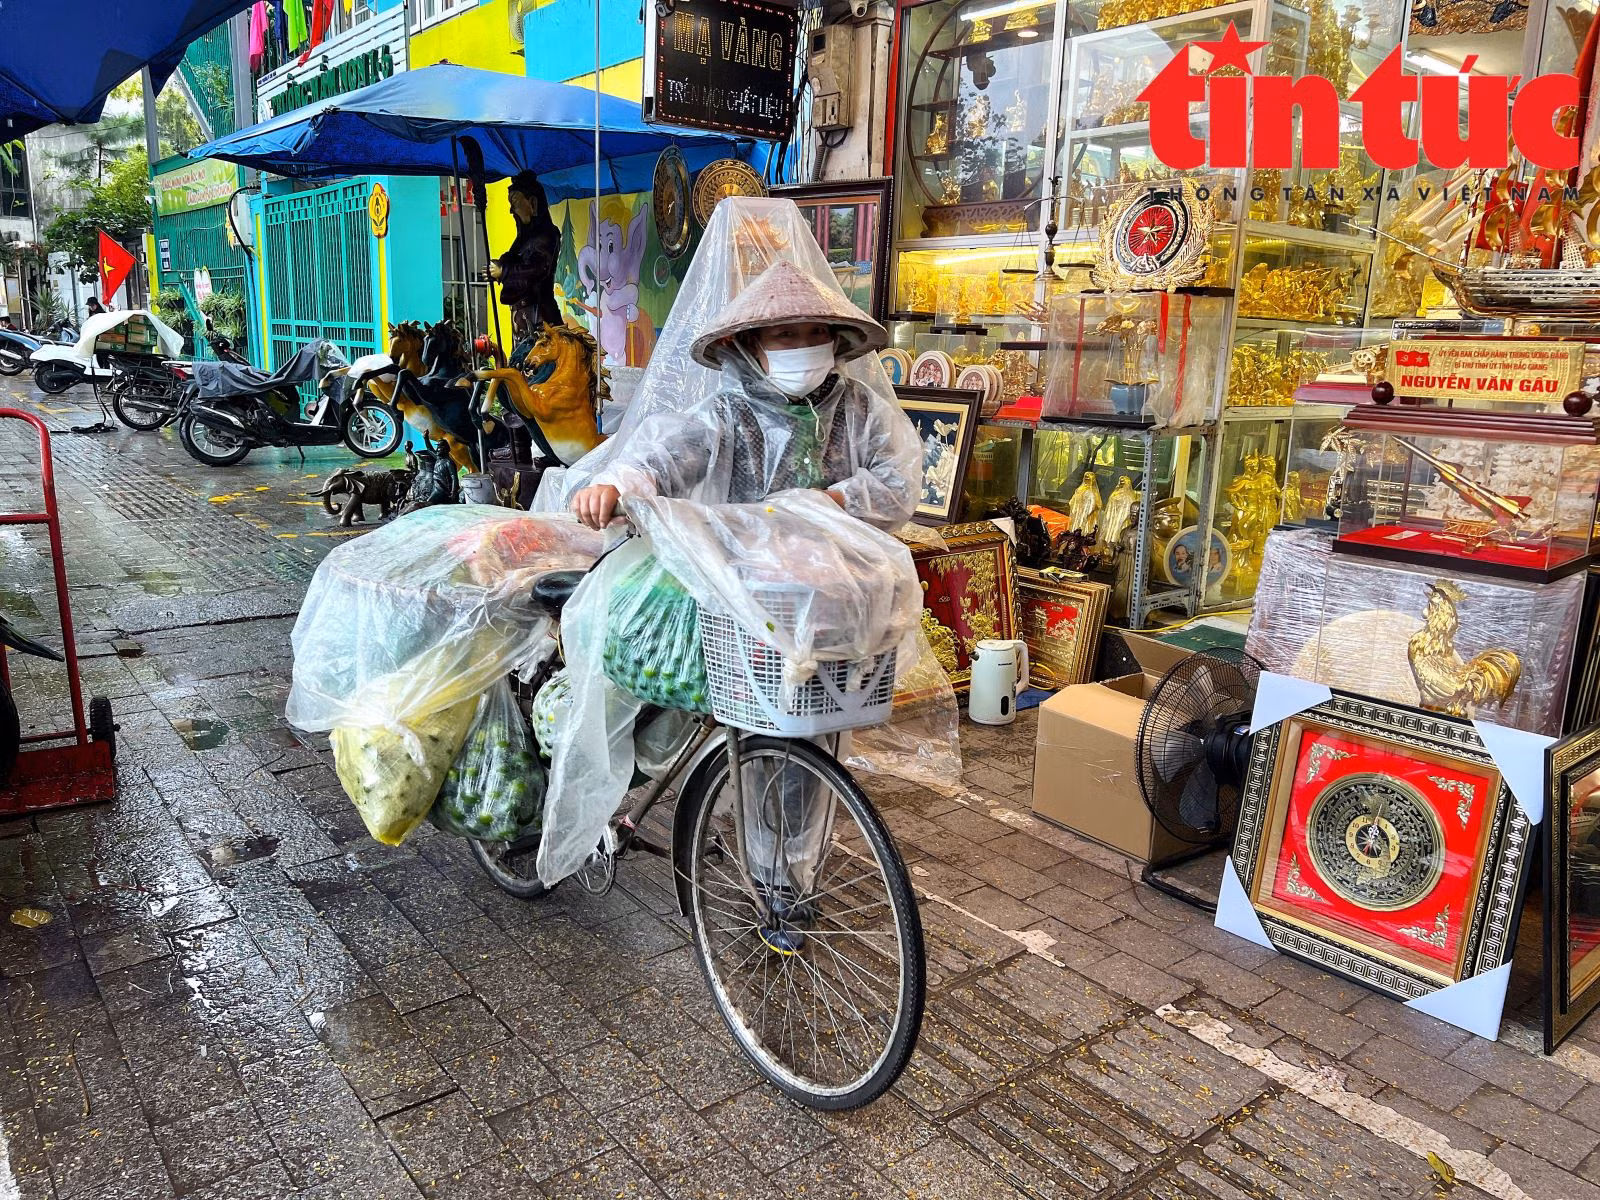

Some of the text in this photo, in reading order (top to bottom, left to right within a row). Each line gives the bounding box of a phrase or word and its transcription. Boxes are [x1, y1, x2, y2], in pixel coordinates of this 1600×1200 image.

[674, 10, 783, 71] MẠ VÀNG
[1400, 372, 1559, 393] NGUYỄN VĂN GẤU
